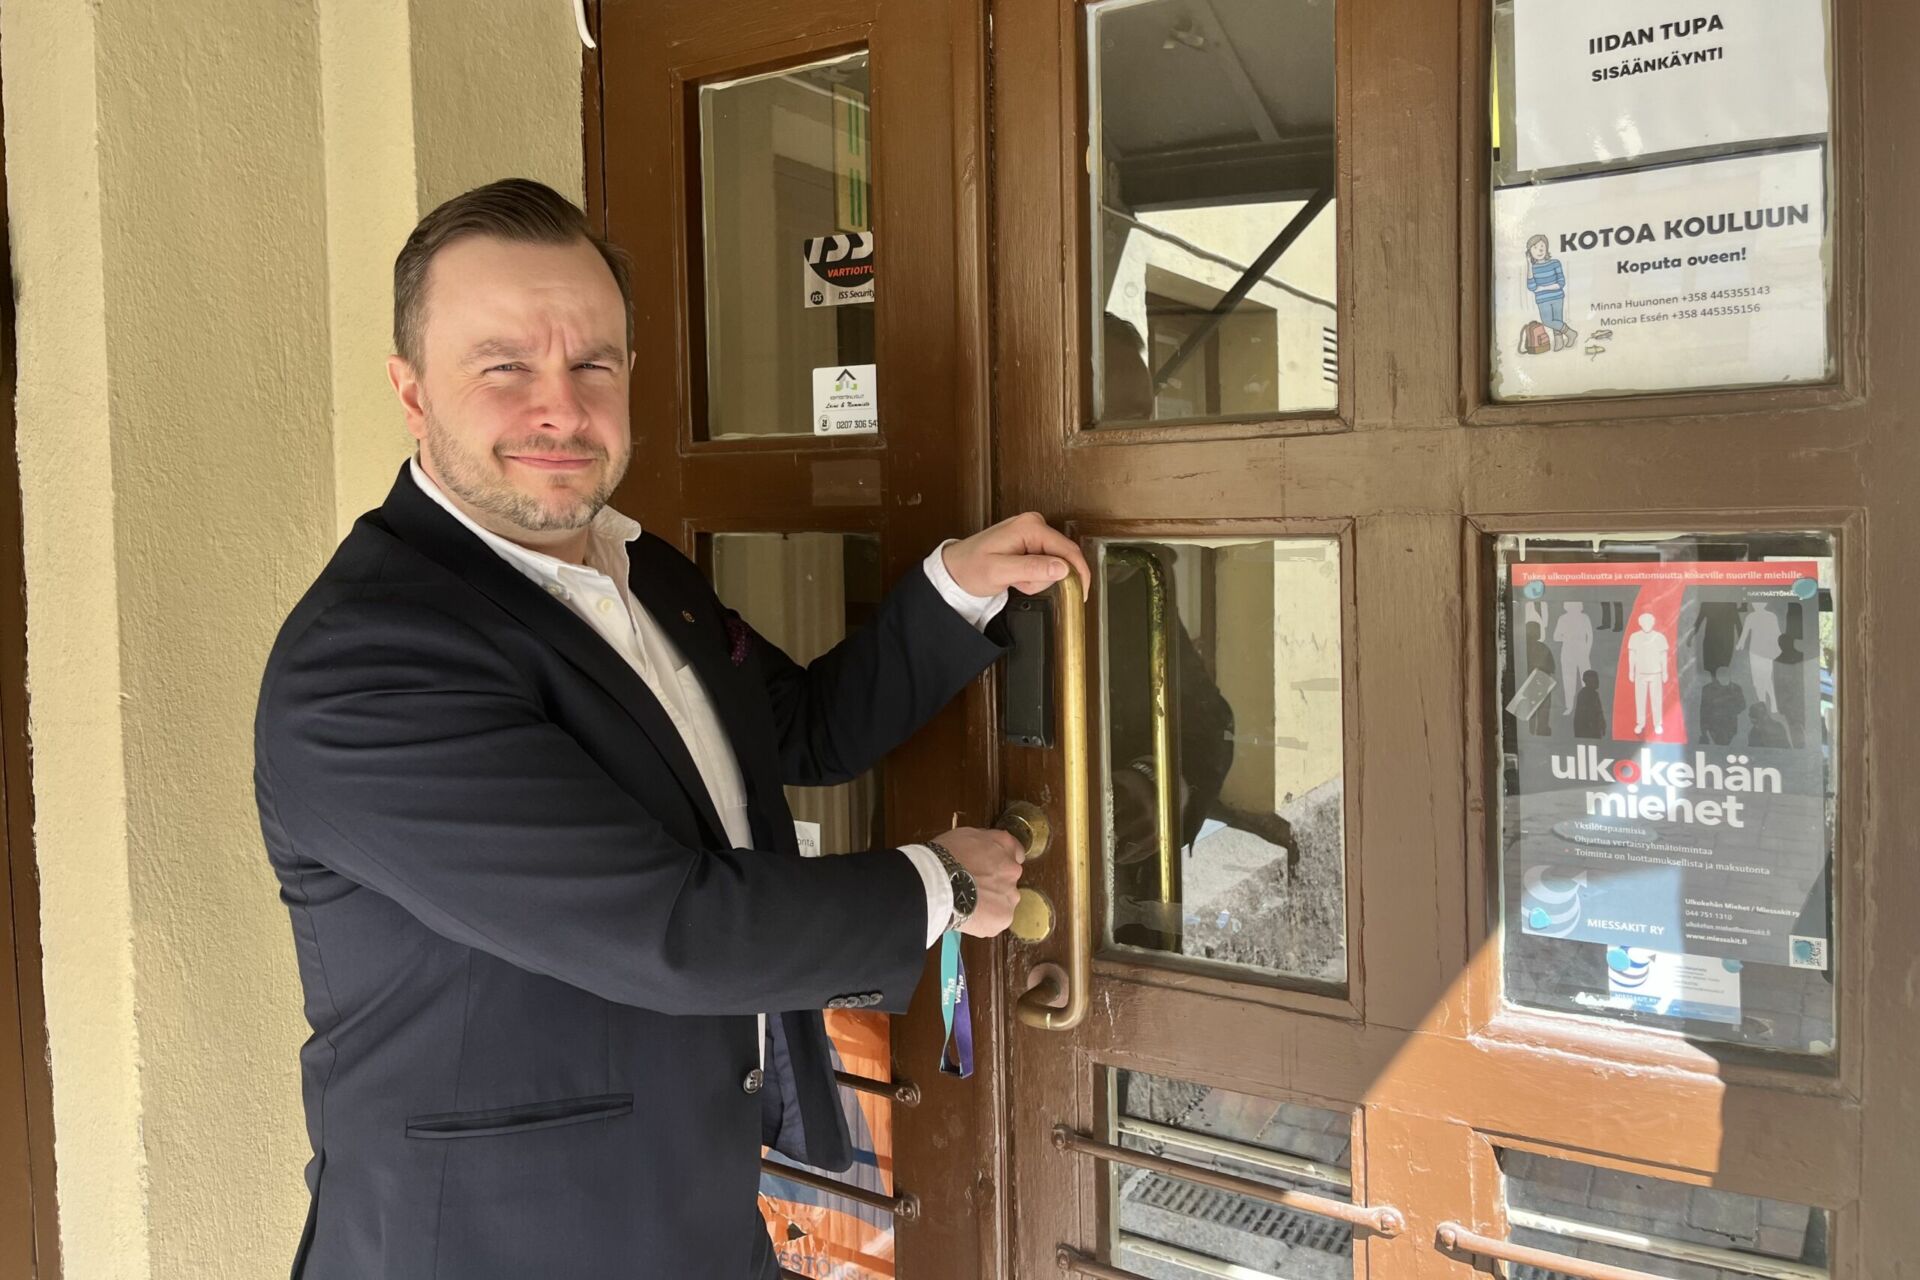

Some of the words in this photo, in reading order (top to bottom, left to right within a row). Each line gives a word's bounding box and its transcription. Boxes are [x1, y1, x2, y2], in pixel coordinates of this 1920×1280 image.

[1589, 27, 1654, 55] IIDAN
[1659, 14, 1724, 41] TUPA
[1591, 47, 1723, 82] SISÄÄNKÄYNTI
[1559, 223, 1656, 253] KOTOA
[1663, 204, 1809, 240] KOULUUN
[1617, 257, 1682, 275] Koputa
[1688, 247, 1747, 266] oveen!
[838, 291, 849, 299] ISS
[1590, 300, 1623, 312] Minna
[1625, 295, 1679, 309] Huunonen
[1682, 291, 1708, 303] +358
[1600, 314, 1637, 327] Monica
[1640, 311, 1669, 324] Essén
[1672, 308, 1698, 320] +358
[836, 420, 853, 430] 0207
[854, 419, 867, 429] 306
[868, 419, 878, 428] 54
[1551, 745, 1782, 794] ulkokehän
[1586, 785, 1745, 828] miehet
[1575, 848, 1613, 859] Toiminta
[1614, 853, 1625, 861] on
[1627, 852, 1704, 868] luottamuksellista
[1705, 861, 1713, 870] ja
[1715, 863, 1771, 875] maksutonta
[1587, 918, 1646, 934] MIESSAKIT
[1650, 925, 1665, 936] RY
